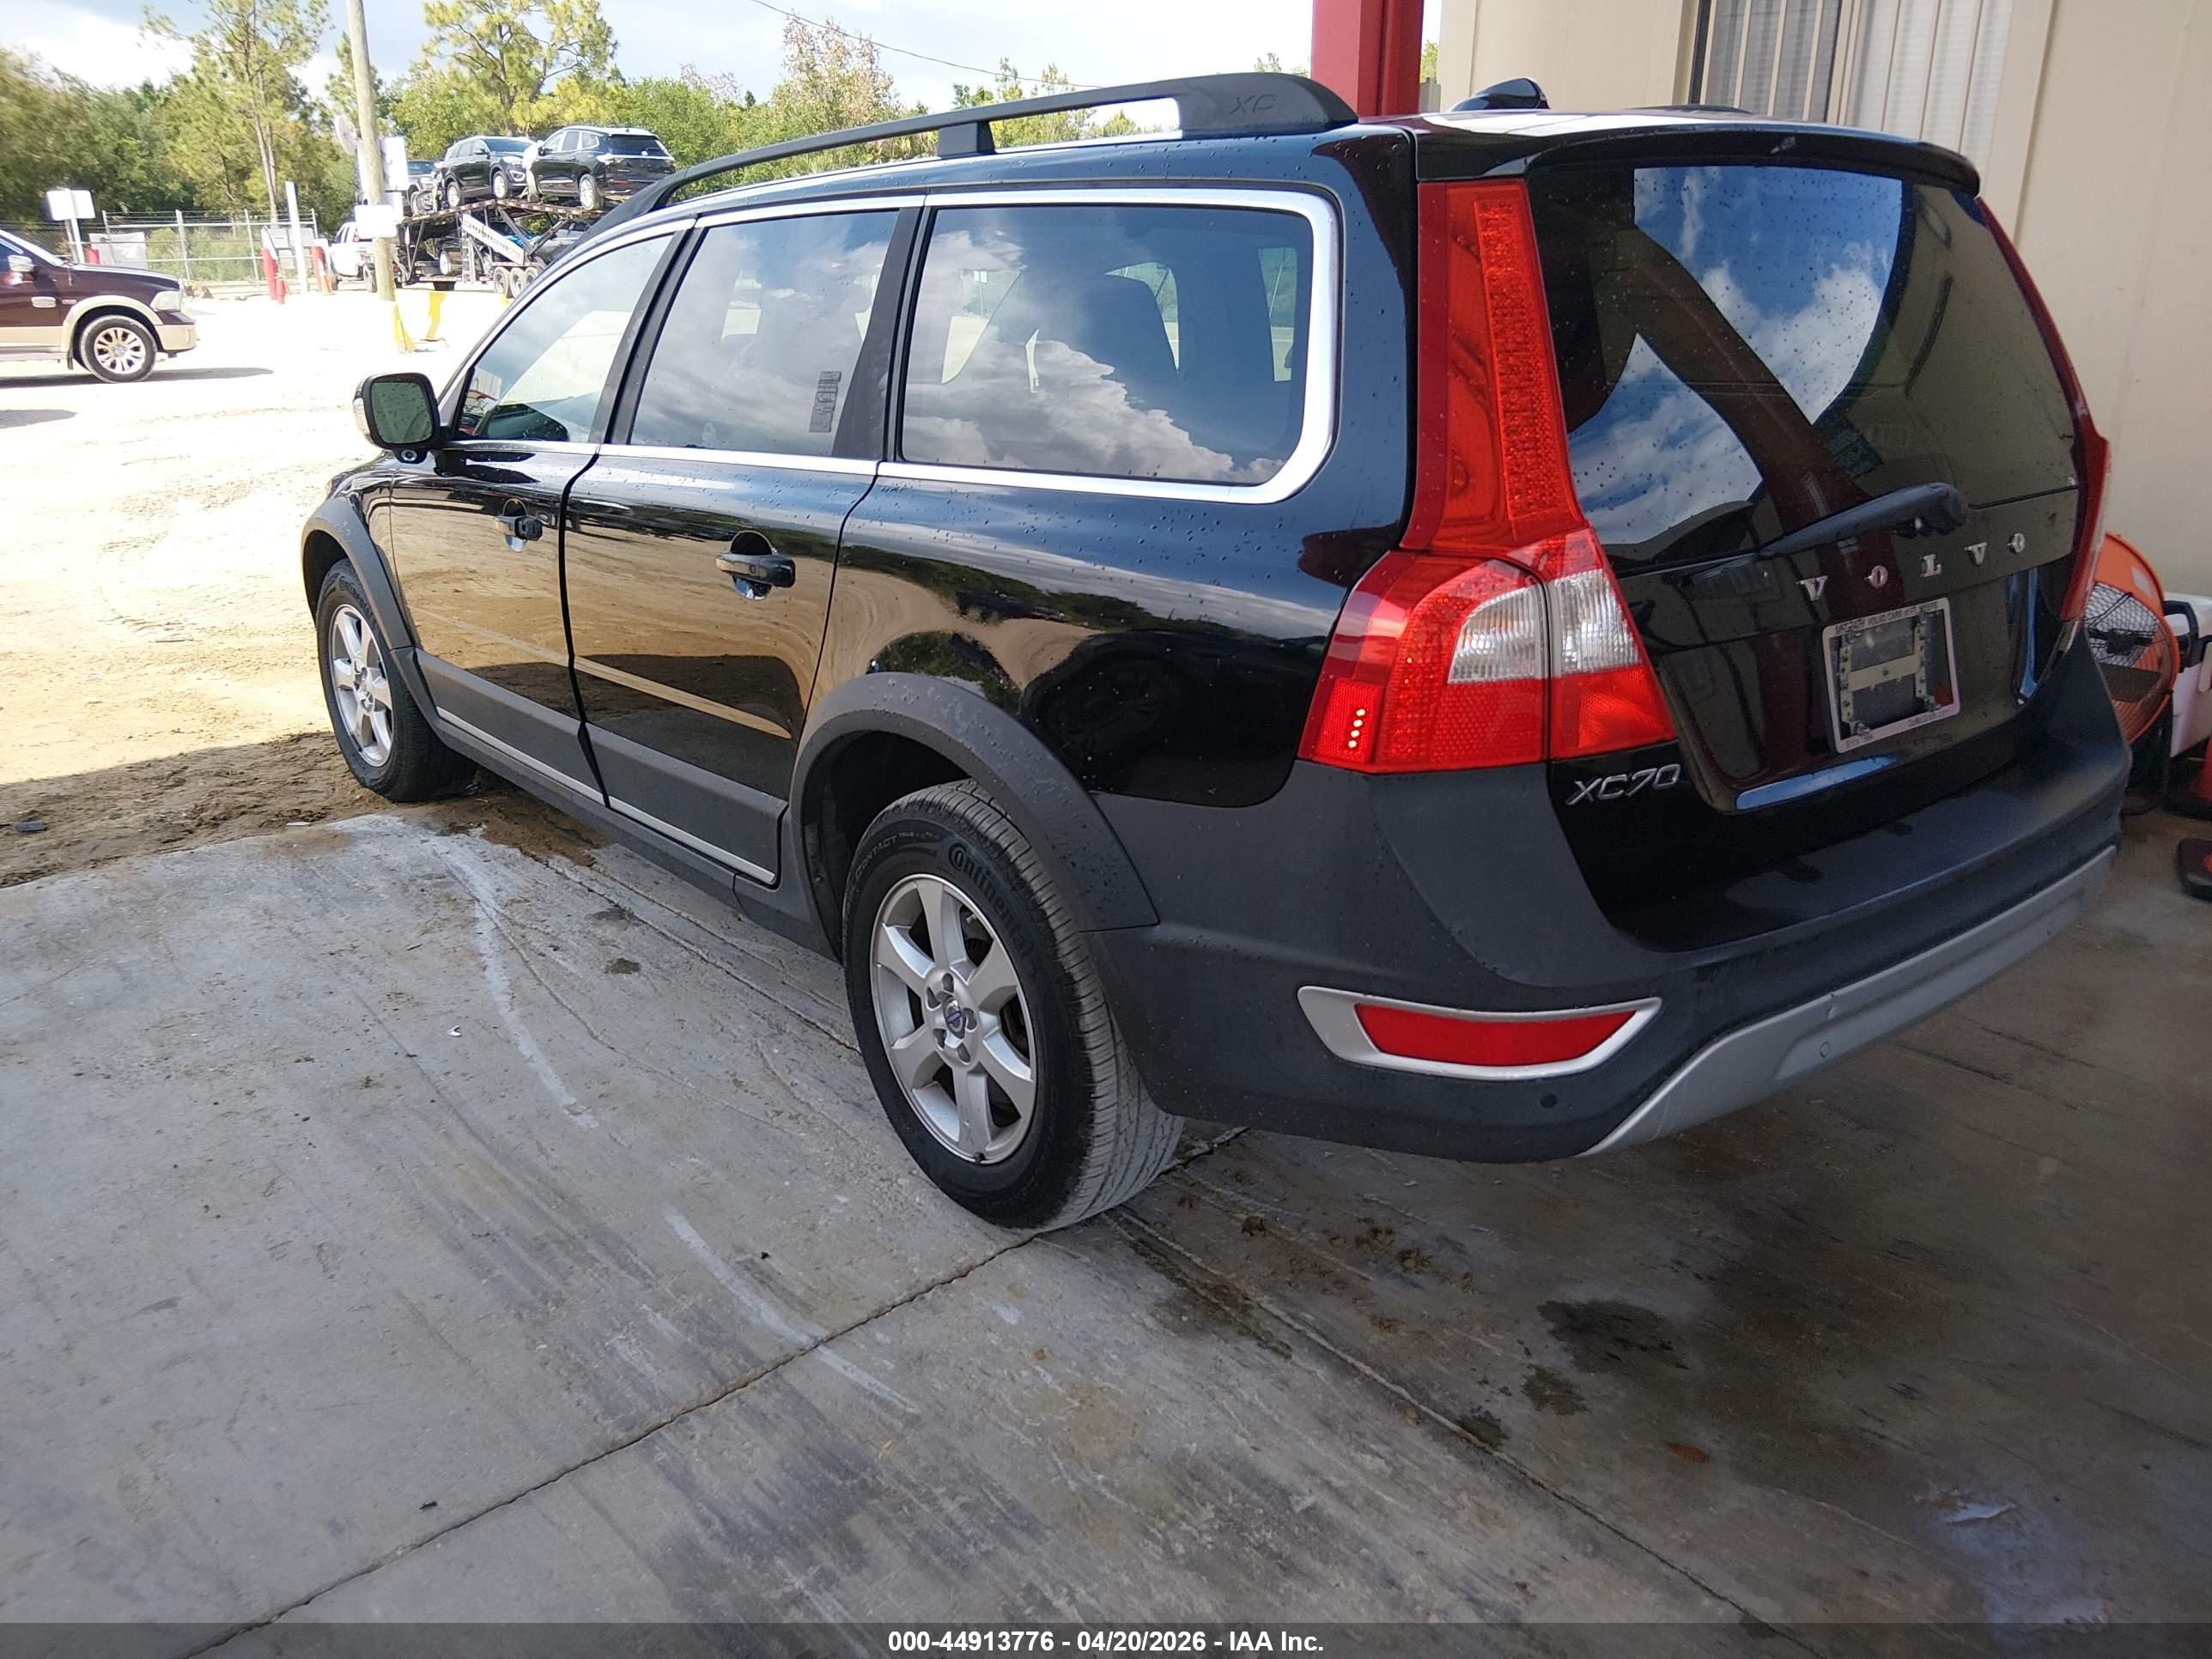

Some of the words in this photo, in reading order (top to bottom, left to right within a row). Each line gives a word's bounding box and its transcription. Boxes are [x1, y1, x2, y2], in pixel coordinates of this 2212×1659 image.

[1230, 94, 1279, 115] XC
[1796, 533, 2026, 601] VOLVO
[1565, 763, 1681, 805] XC70
